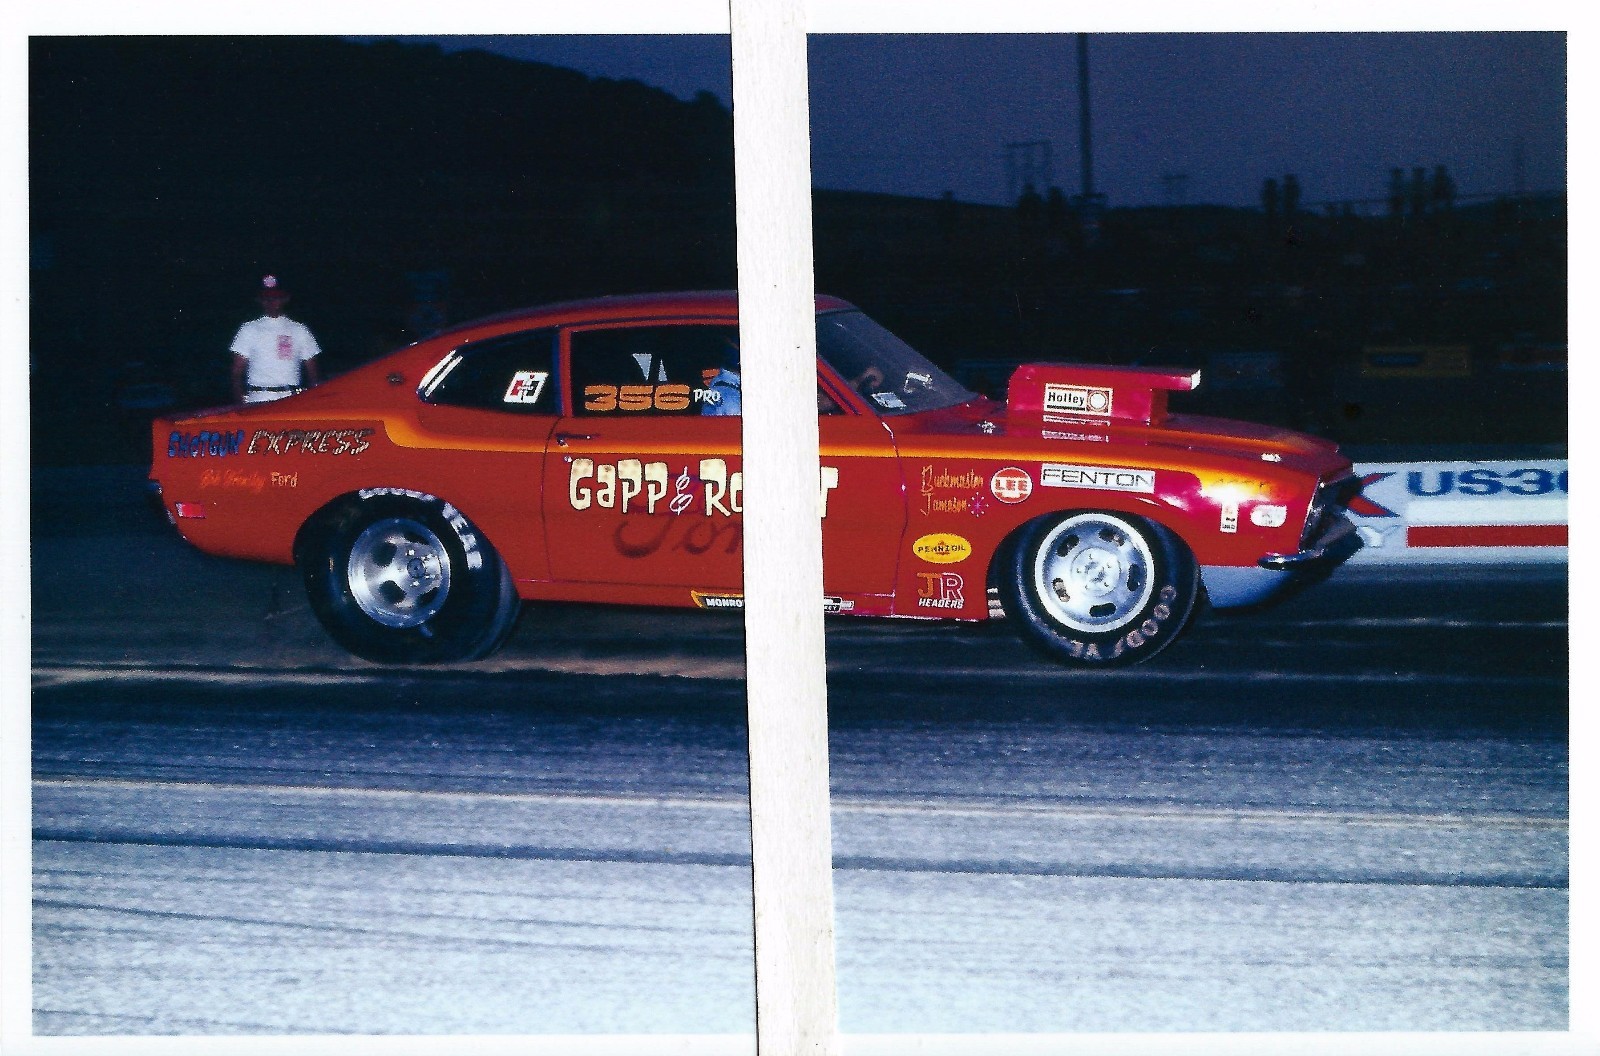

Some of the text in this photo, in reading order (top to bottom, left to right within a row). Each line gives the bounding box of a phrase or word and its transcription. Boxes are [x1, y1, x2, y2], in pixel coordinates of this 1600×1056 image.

[585, 384, 721, 411] 356 PRO
[1047, 391, 1085, 406] Holley
[247, 428, 376, 455] EXPRESS
[270, 471, 298, 488] Ford
[995, 479, 1028, 491] LEE
[1042, 468, 1154, 487] FENTON
[1407, 468, 1568, 497] US3
[669, 465, 694, 516] &
[705, 597, 744, 608] MONRO
[918, 597, 964, 609] HEADERS
